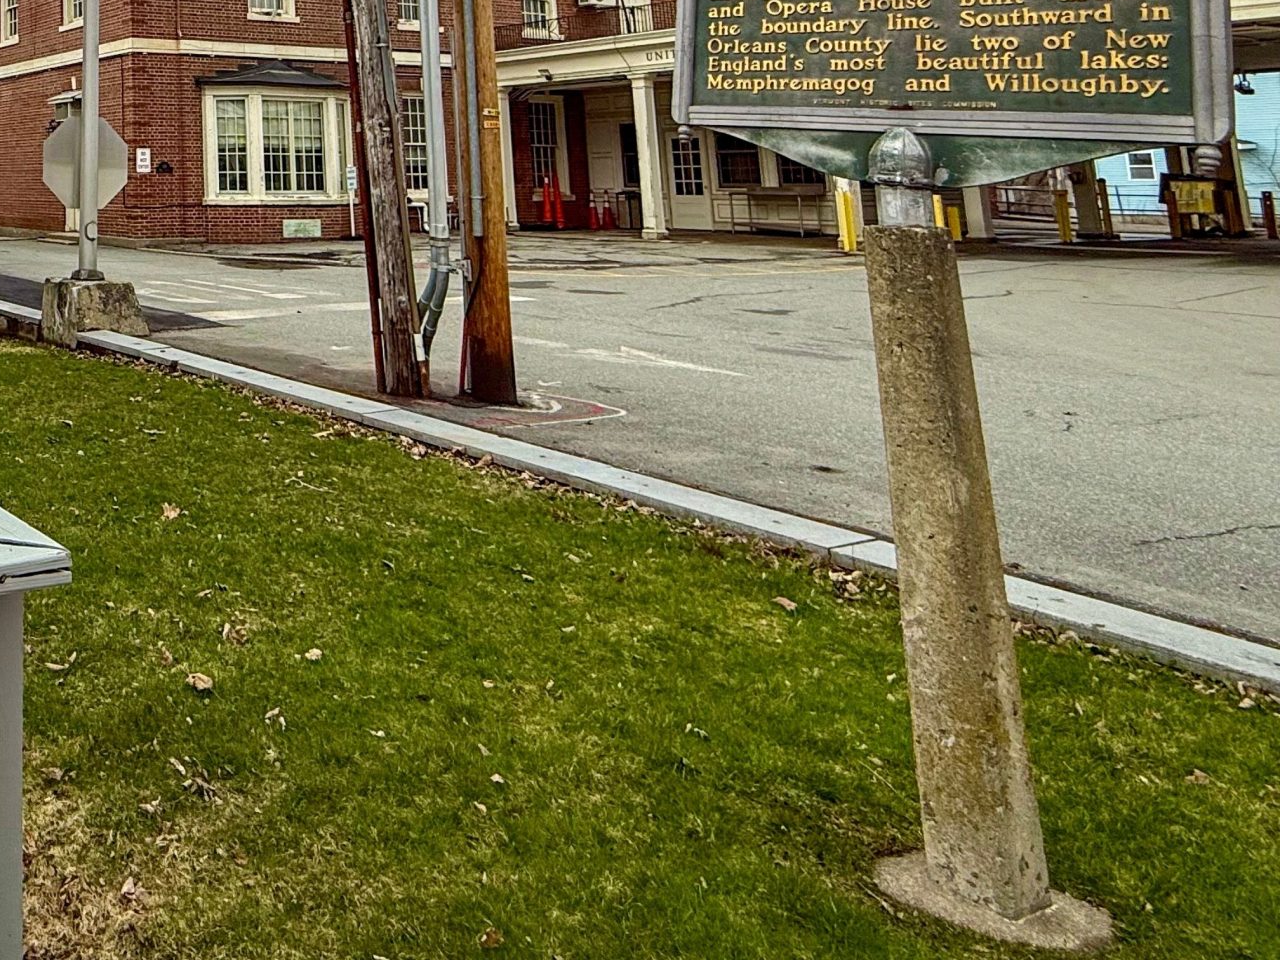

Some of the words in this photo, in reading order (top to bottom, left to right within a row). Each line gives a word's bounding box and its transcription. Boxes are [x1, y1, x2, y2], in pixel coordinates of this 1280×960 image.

[708, 2, 743, 19] and
[765, 0, 832, 17] Opera
[708, 20, 741, 35] the
[761, 17, 866, 38] boundary
[886, 12, 938, 30] line.
[959, 5, 1111, 27] Southward
[1140, 4, 1170, 21] in
[707, 38, 787, 53] Orleans
[804, 36, 891, 55] County
[914, 33, 946, 51] lie
[970, 35, 1017, 51] two
[1043, 32, 1075, 51] of
[1104, 30, 1170, 48] New
[830, 55, 885, 70] most
[917, 53, 1043, 70] beautiful
[1079, 51, 1168, 69] lakes:
[706, 75, 875, 94] Memphremagog
[905, 75, 951, 92] and
[984, 74, 1169, 96] Willoughby.
[942, 100, 997, 108] COMMISSION
